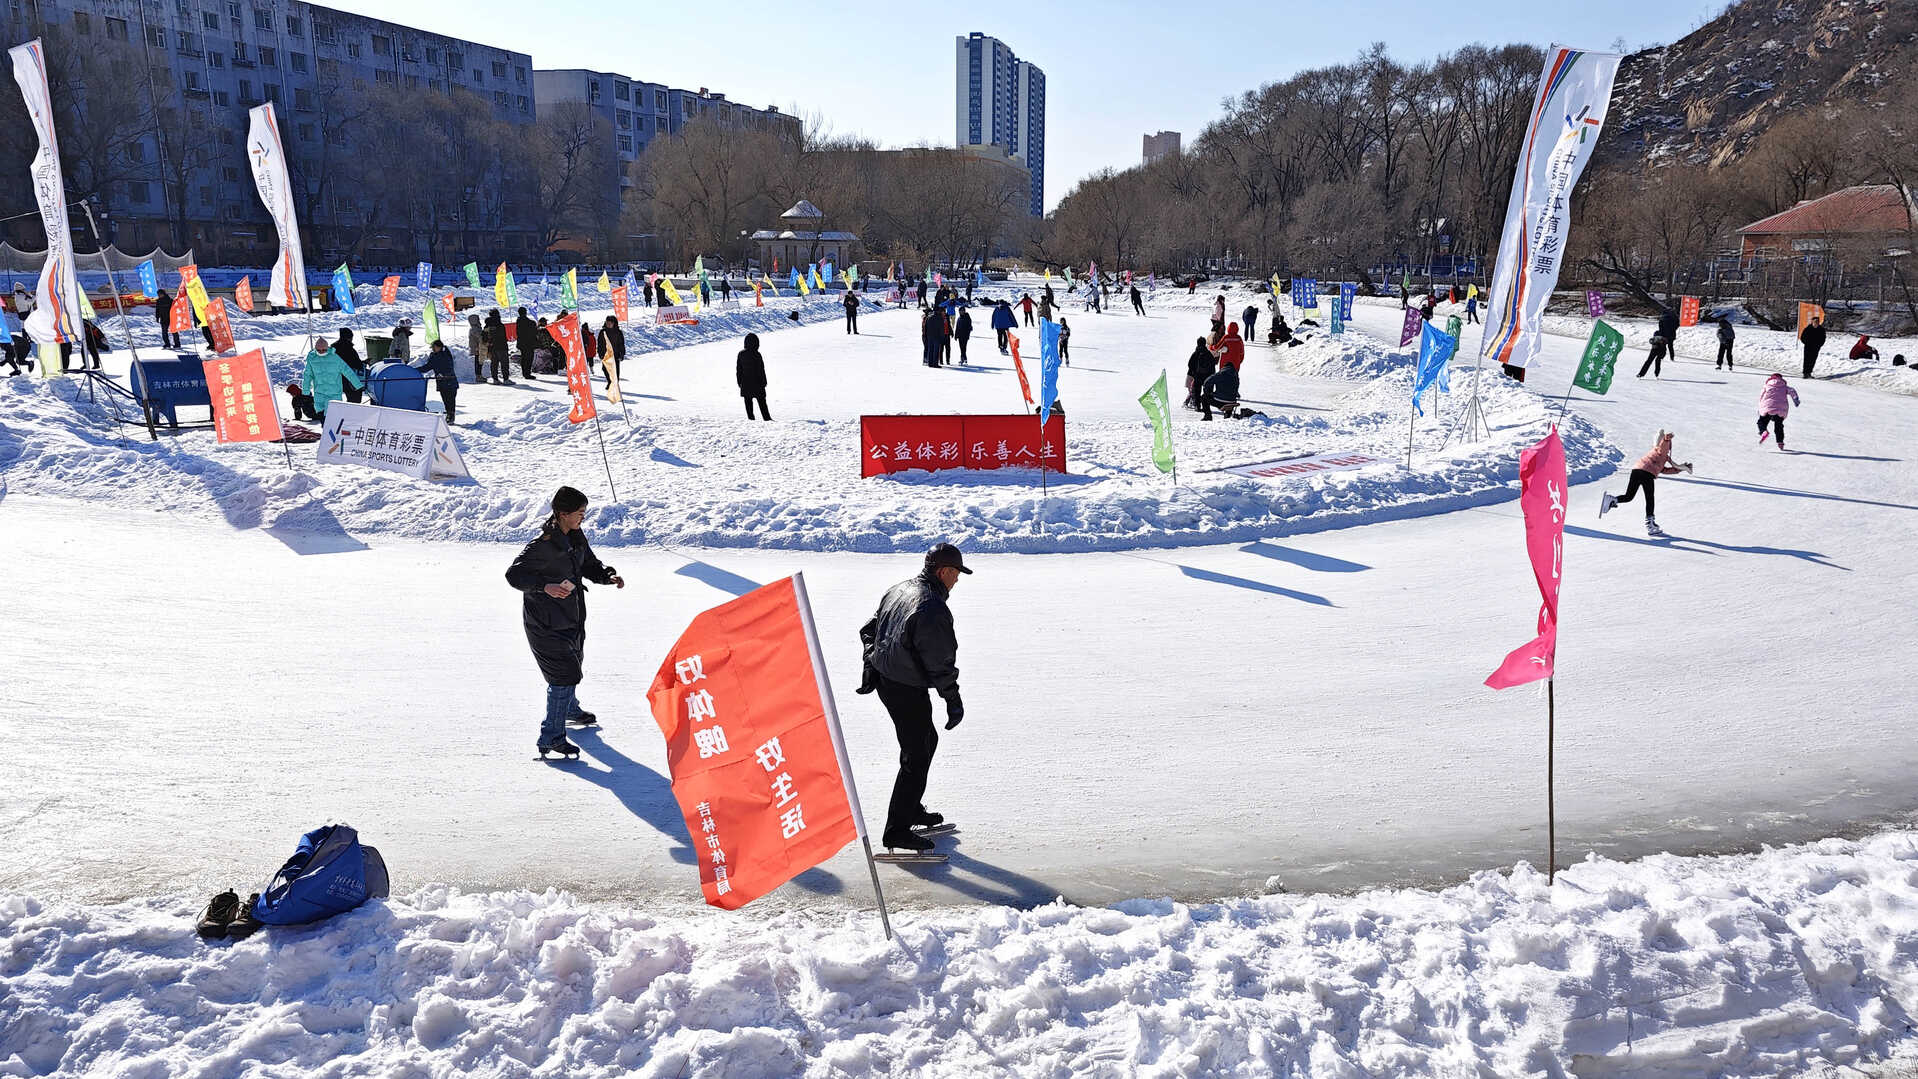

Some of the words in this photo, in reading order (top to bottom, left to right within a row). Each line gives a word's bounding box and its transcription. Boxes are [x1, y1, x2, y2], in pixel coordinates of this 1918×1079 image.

[1534, 151, 1576, 274] 中国体育彩票
[354, 426, 425, 454] 中国体育彩票
[870, 440, 959, 461] 公益体彩
[971, 440, 1057, 461] 乐善人生
[350, 449, 367, 458] CHINA
[367, 451, 393, 463] SPORTS
[393, 456, 420, 468] LOTTERY
